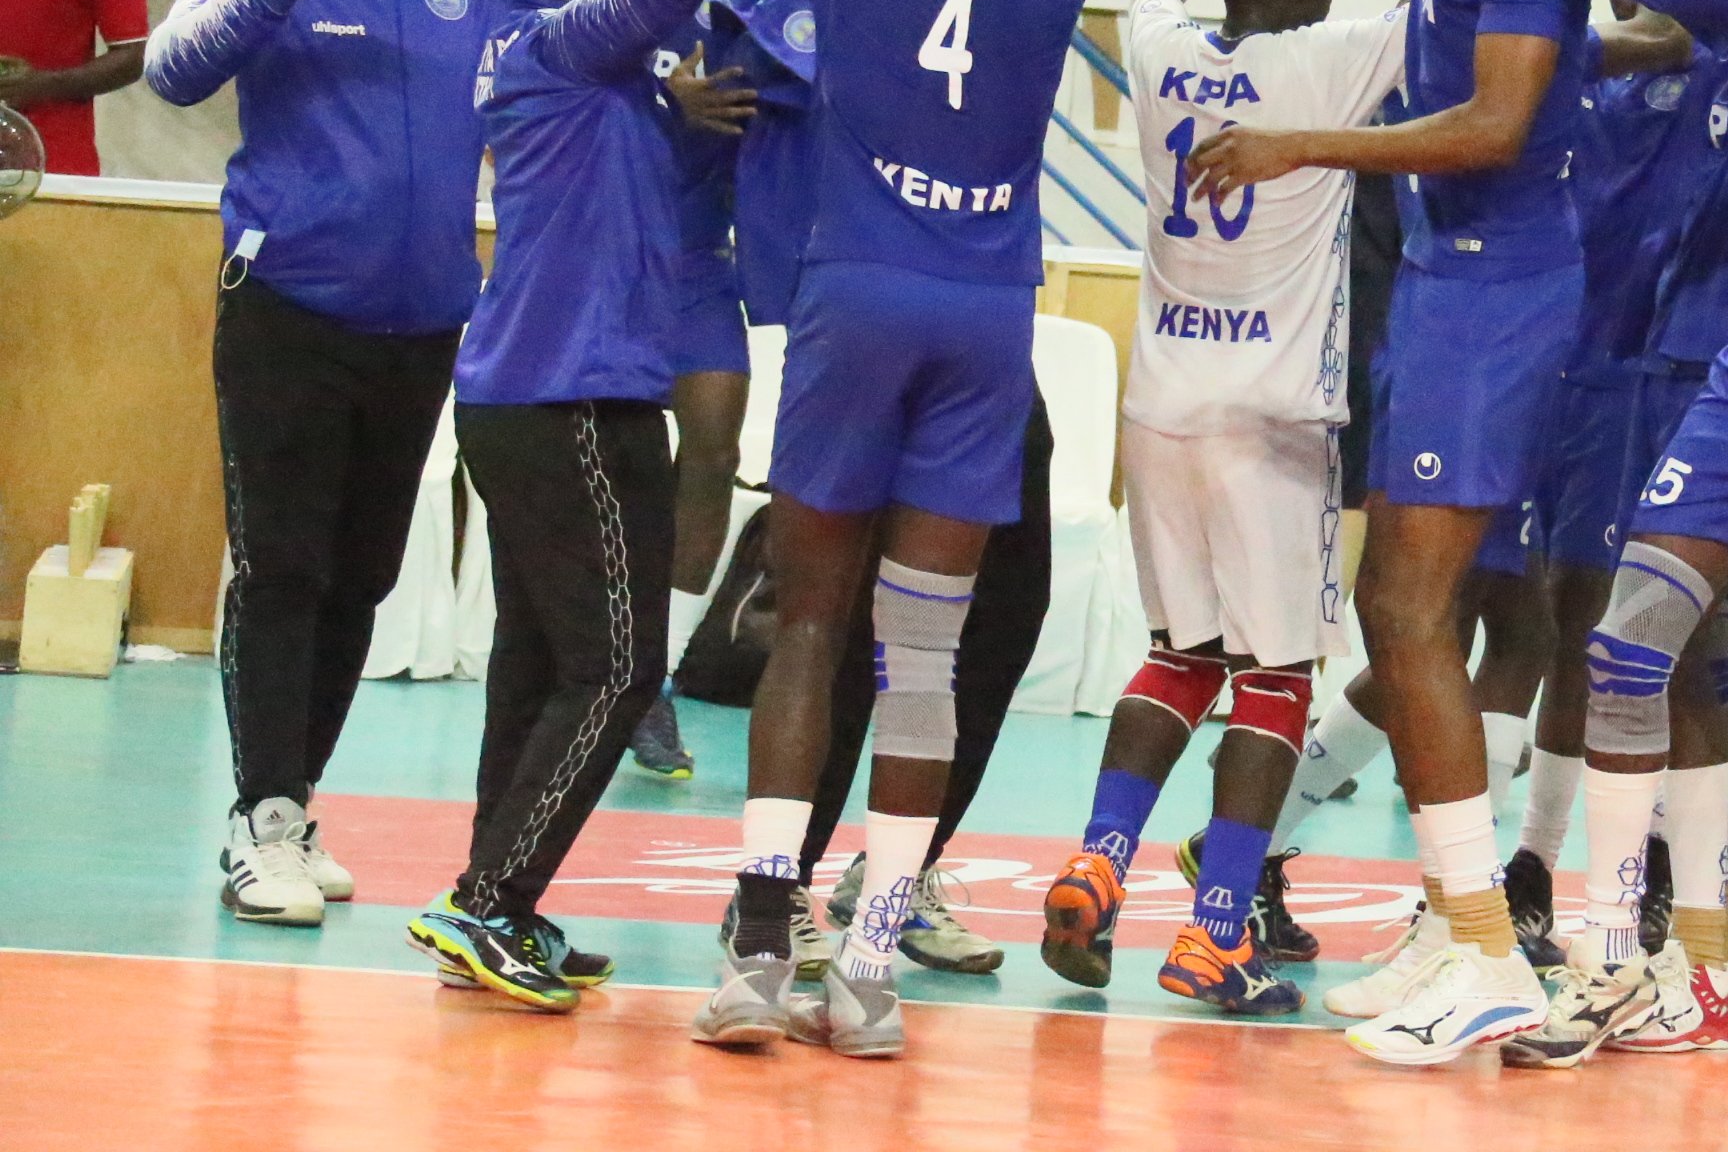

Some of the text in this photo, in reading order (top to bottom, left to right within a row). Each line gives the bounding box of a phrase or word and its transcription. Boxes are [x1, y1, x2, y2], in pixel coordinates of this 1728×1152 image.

[311, 20, 366, 36] uhlsport
[1159, 66, 1260, 108] KPA
[873, 156, 1012, 212] KENYA
[1155, 302, 1272, 343] KENYA
